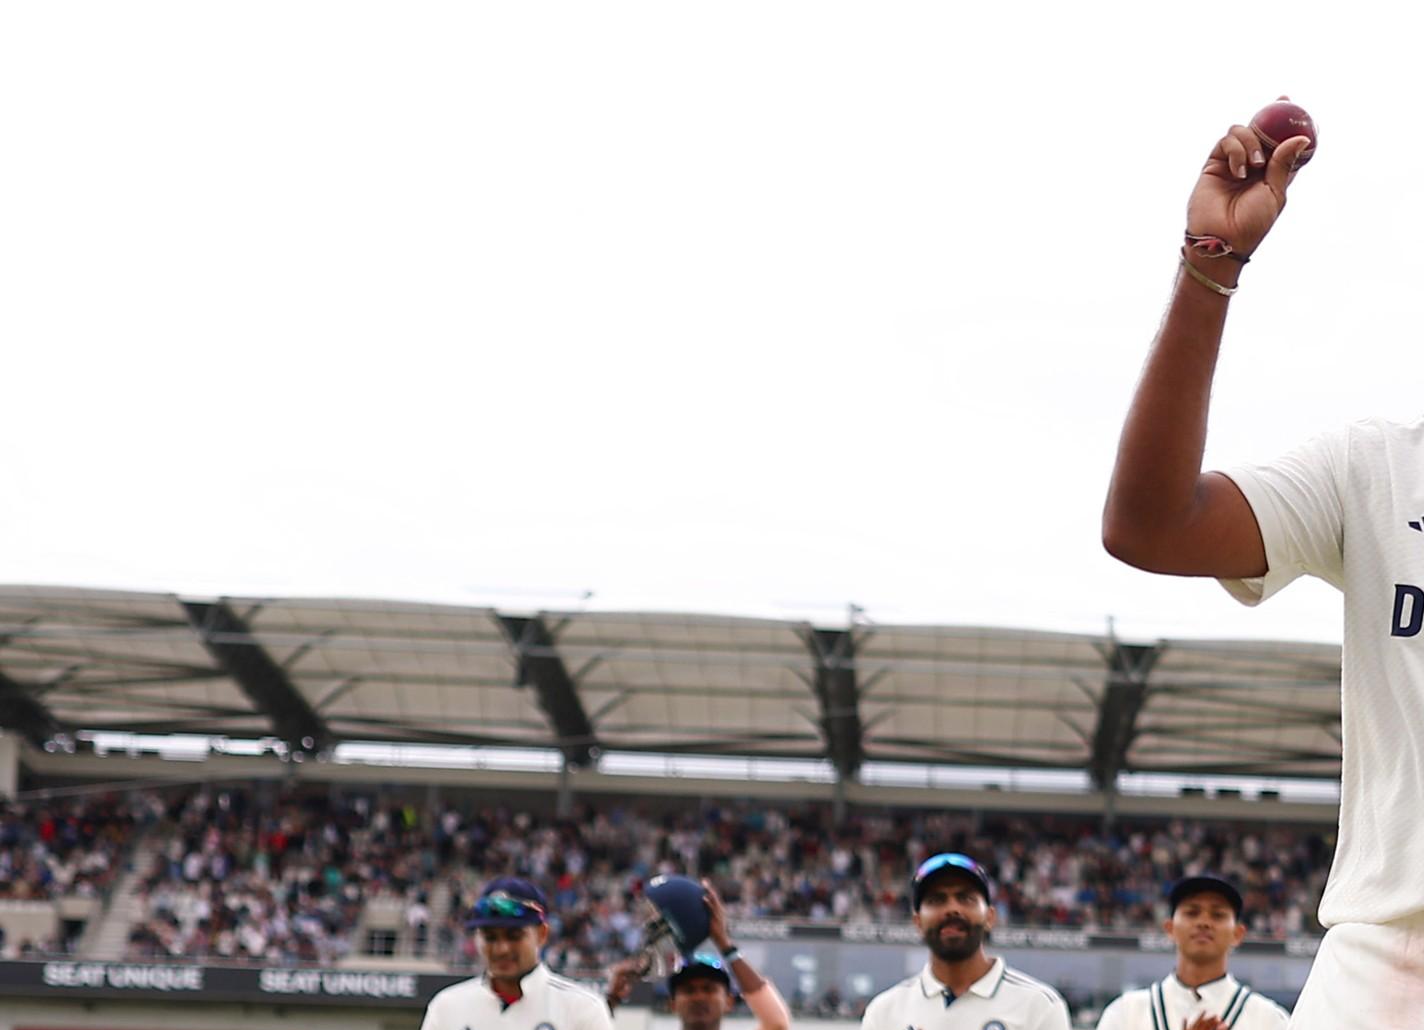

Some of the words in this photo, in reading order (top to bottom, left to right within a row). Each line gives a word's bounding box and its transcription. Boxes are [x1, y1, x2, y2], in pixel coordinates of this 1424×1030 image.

[44, 963, 104, 986] SEAT
[108, 965, 203, 990] UNIQUE
[260, 970, 319, 994] SEAT
[323, 972, 417, 997] UNIQUE
